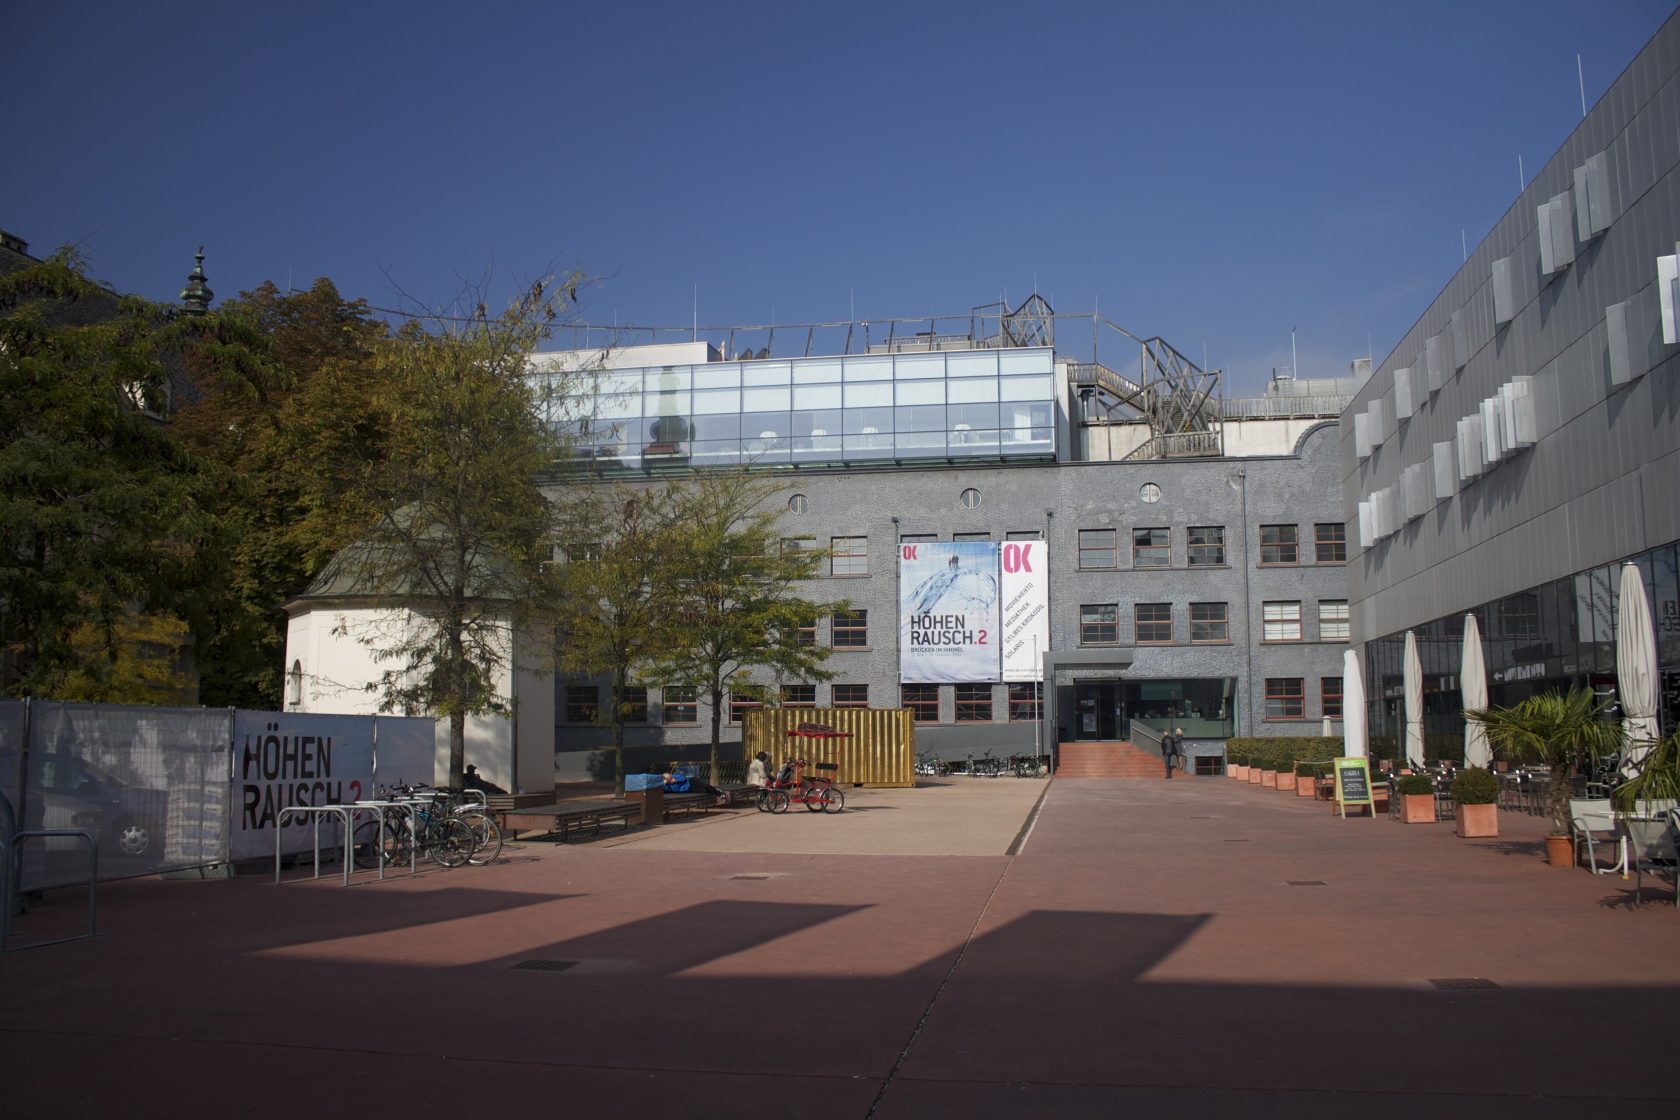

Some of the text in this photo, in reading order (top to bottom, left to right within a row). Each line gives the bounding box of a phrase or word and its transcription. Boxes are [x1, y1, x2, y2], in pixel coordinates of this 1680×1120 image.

[902, 545, 918, 560] OK
[1003, 543, 1033, 574] OK
[1004, 582, 1034, 613] MOVIEMENTO
[910, 611, 965, 630] HÖHEN
[1004, 601, 1031, 628] MEDIATHEK
[1004, 602, 1046, 644] GELBES KROKODIL
[910, 629, 988, 646] RAUSCH.2
[1004, 640, 1025, 660] SOLARIS
[242, 722, 332, 780] HÖHEN
